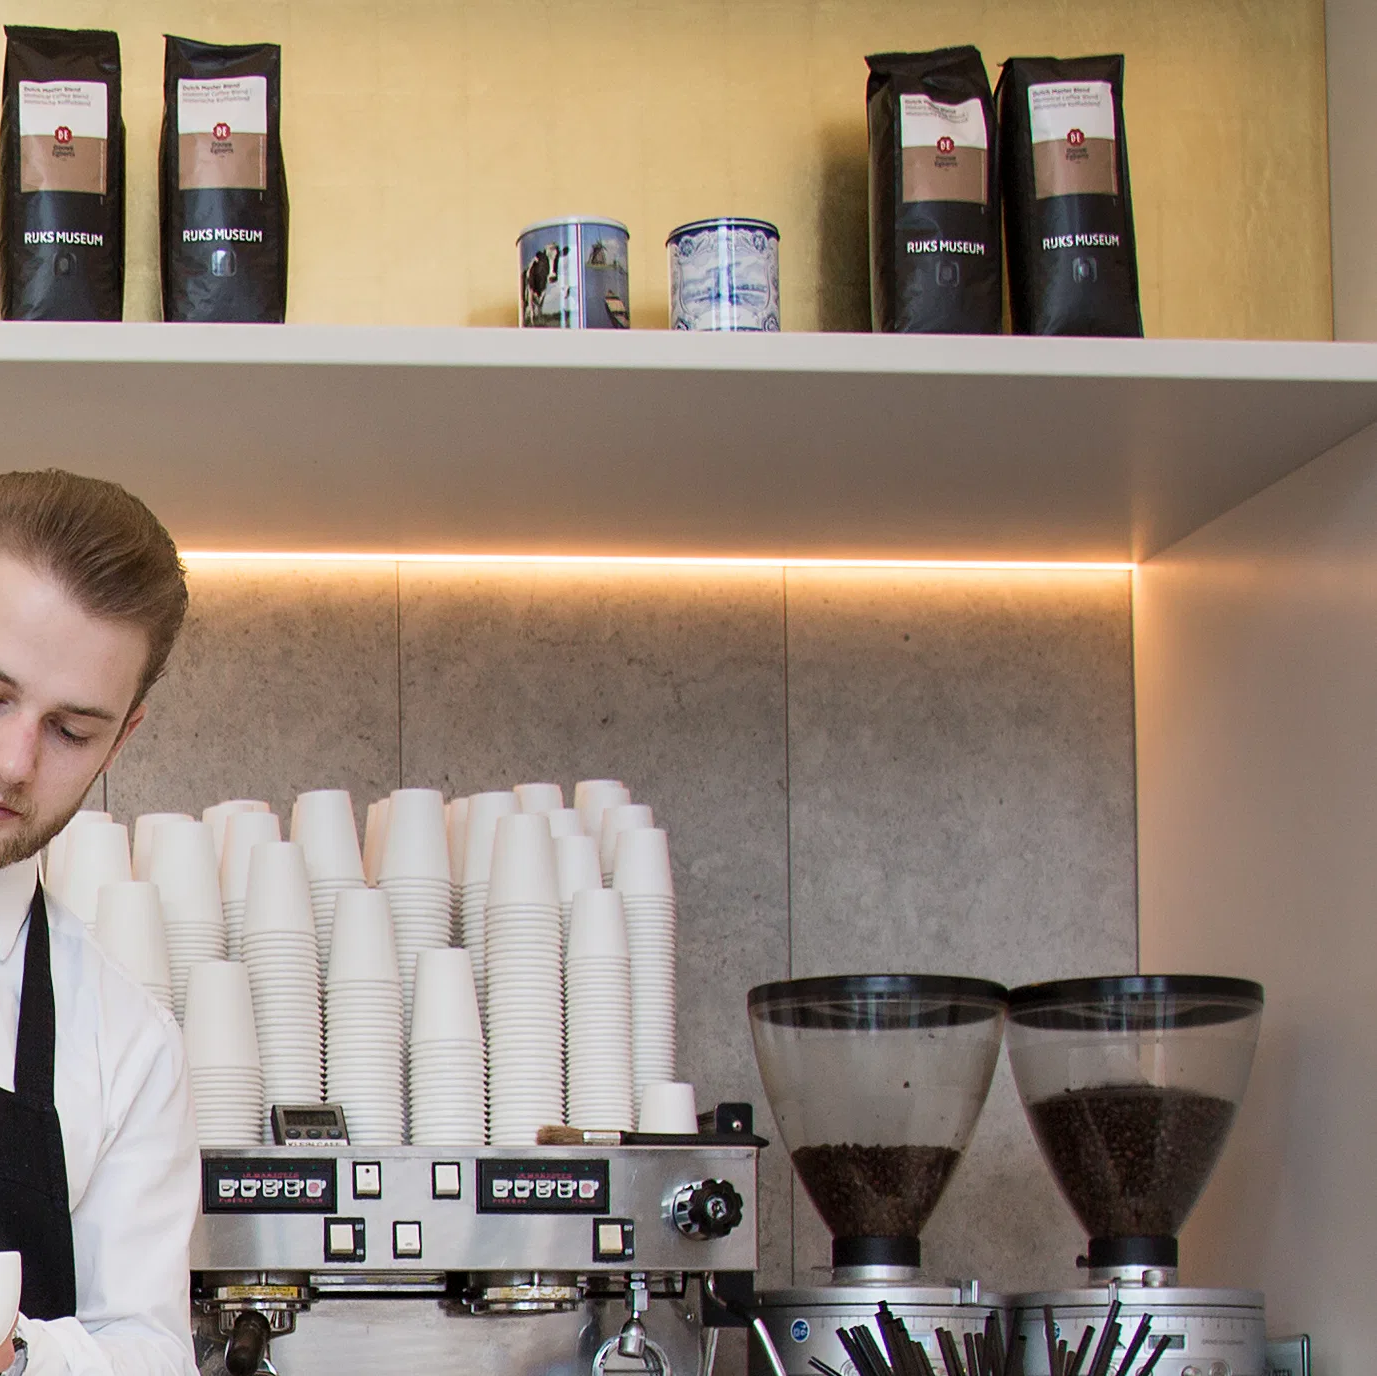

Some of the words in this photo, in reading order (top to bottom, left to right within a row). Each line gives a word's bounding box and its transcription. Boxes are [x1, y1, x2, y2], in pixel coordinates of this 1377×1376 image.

[24, 231, 54, 245] RIJKS
[56, 231, 103, 246] MUSEUM
[182, 229, 212, 242] RIJKS
[215, 228, 263, 242] MUSEUM
[1042, 237, 1073, 250] RIJKS
[1075, 233, 1119, 247] MUSEUM
[907, 241, 937, 254] RIJKS
[939, 241, 985, 255] MUSEUM
